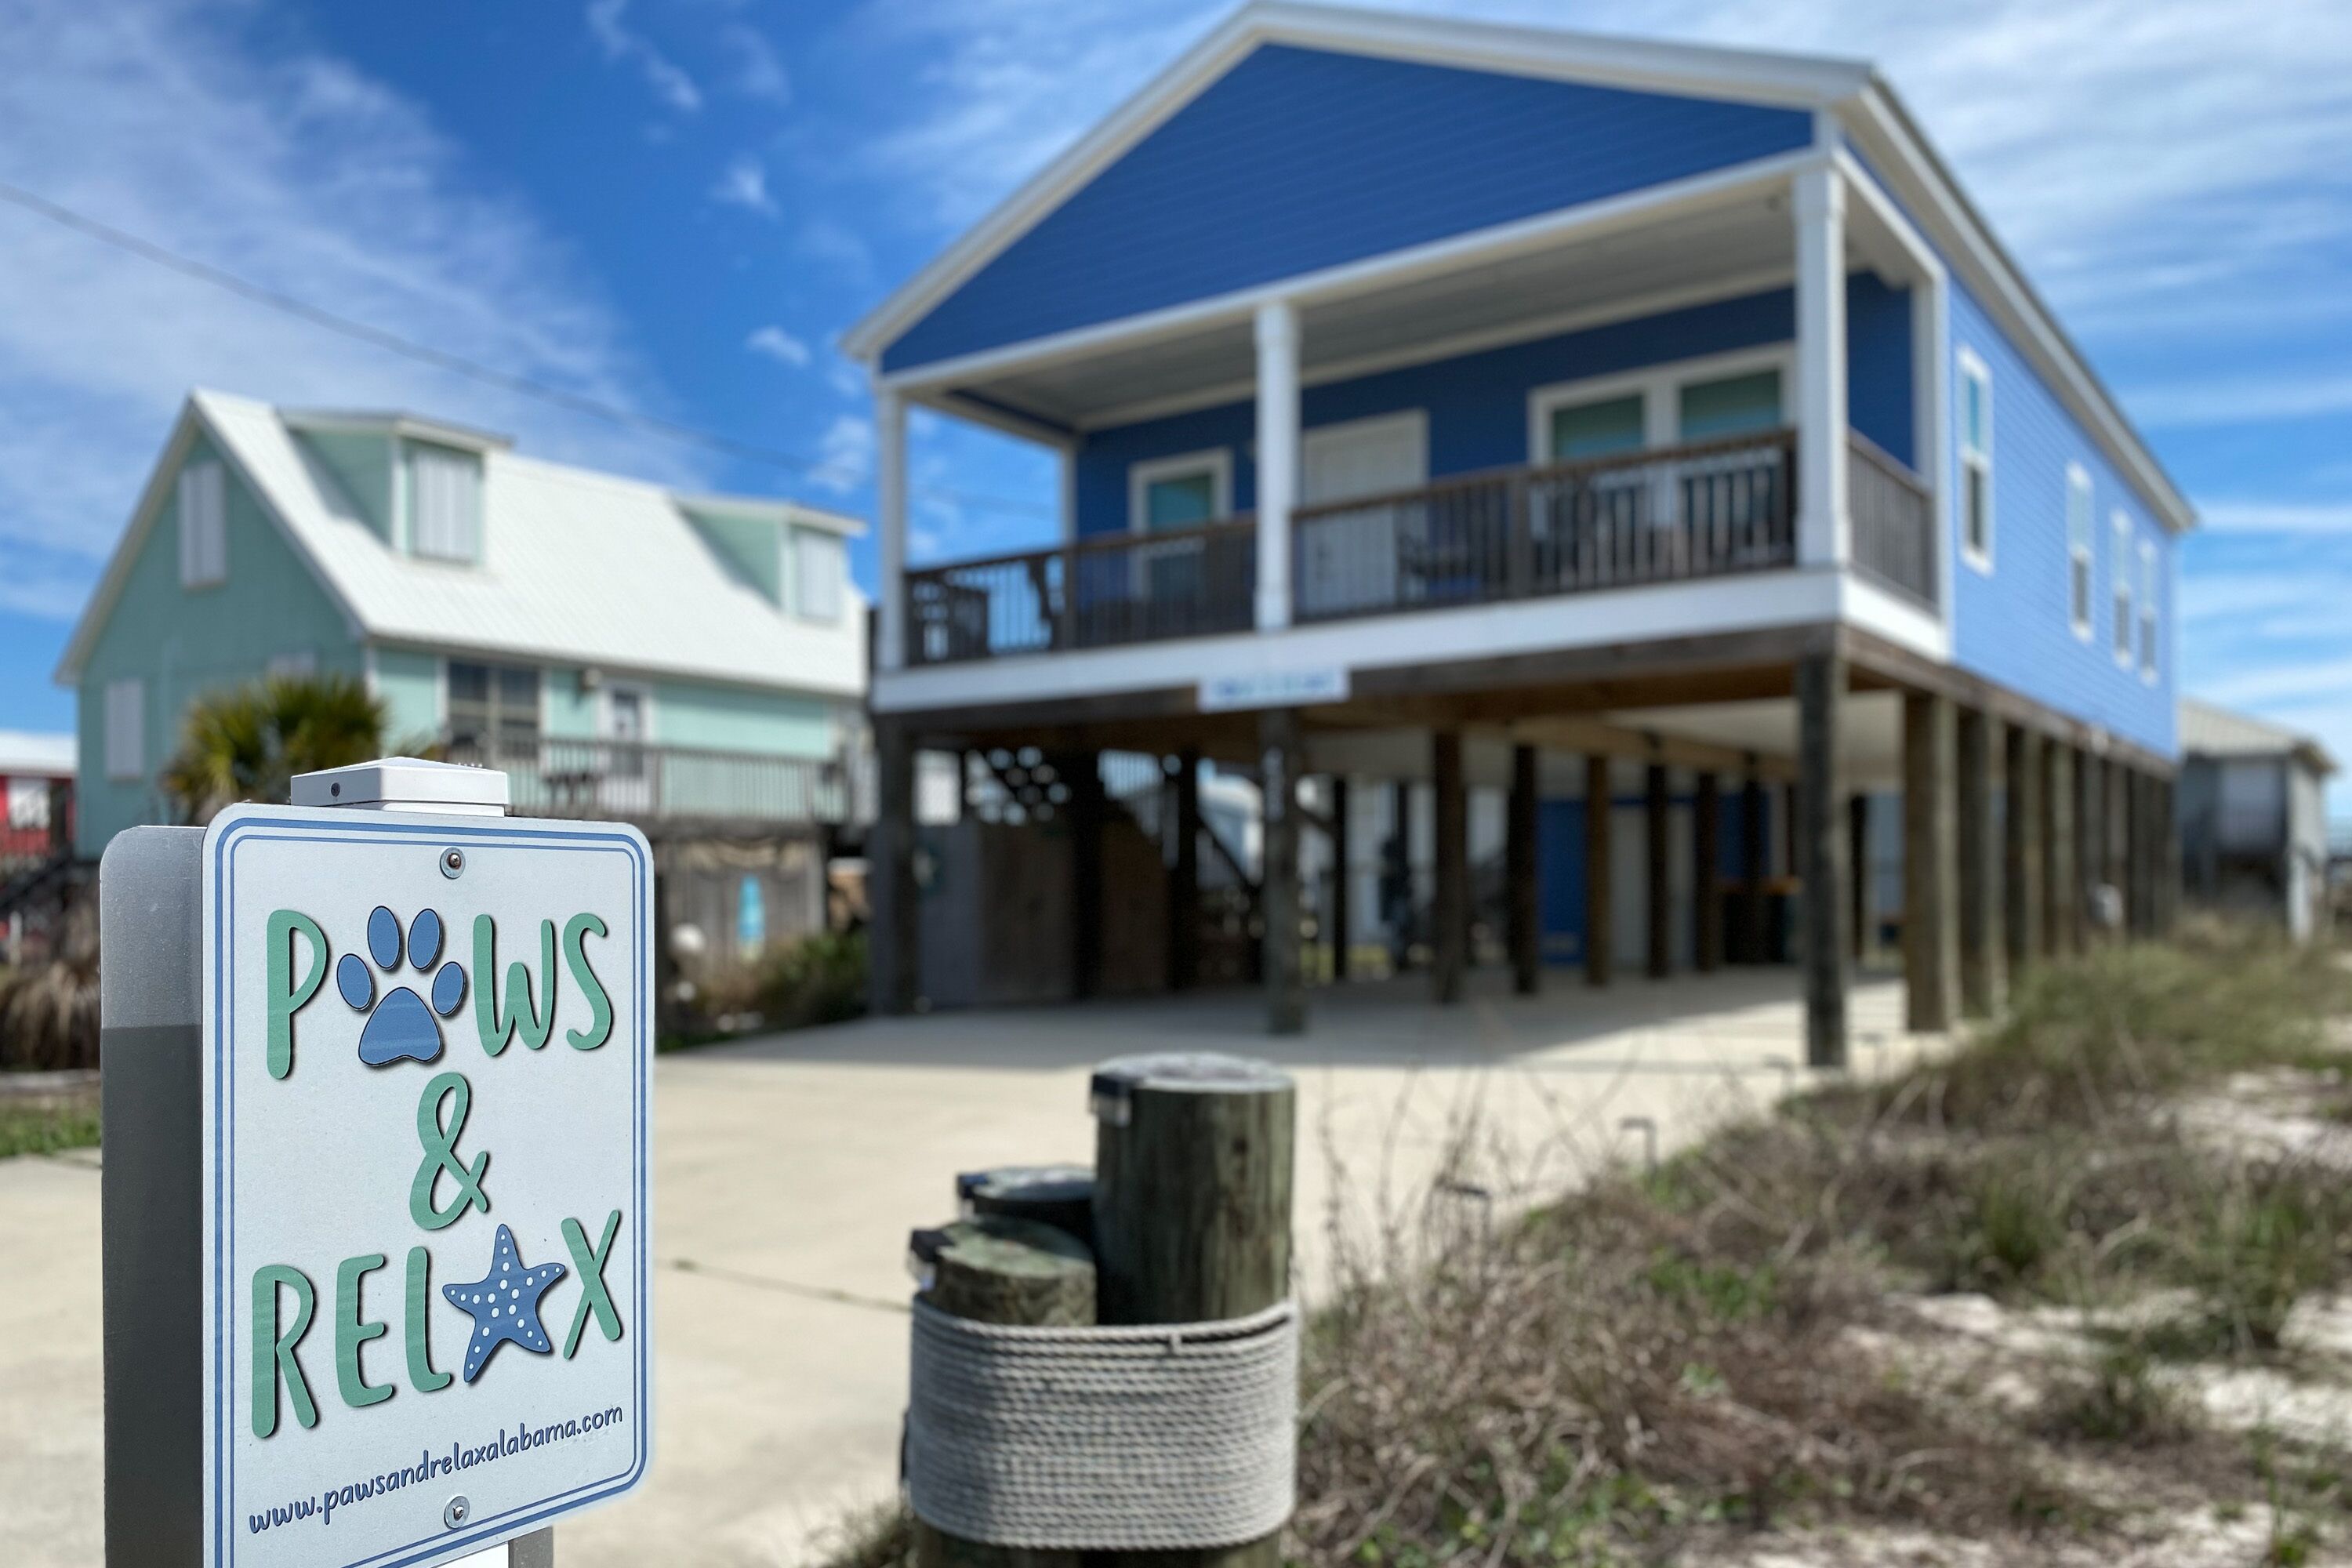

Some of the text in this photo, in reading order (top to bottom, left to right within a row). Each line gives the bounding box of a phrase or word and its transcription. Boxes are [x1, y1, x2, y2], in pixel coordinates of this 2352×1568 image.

[267, 906, 615, 1080] PWS
[409, 1072, 489, 1231] &
[252, 1210, 623, 1439] RELX
[249, 1406, 623, 1534] www.pawsandrelaxalabama.com
